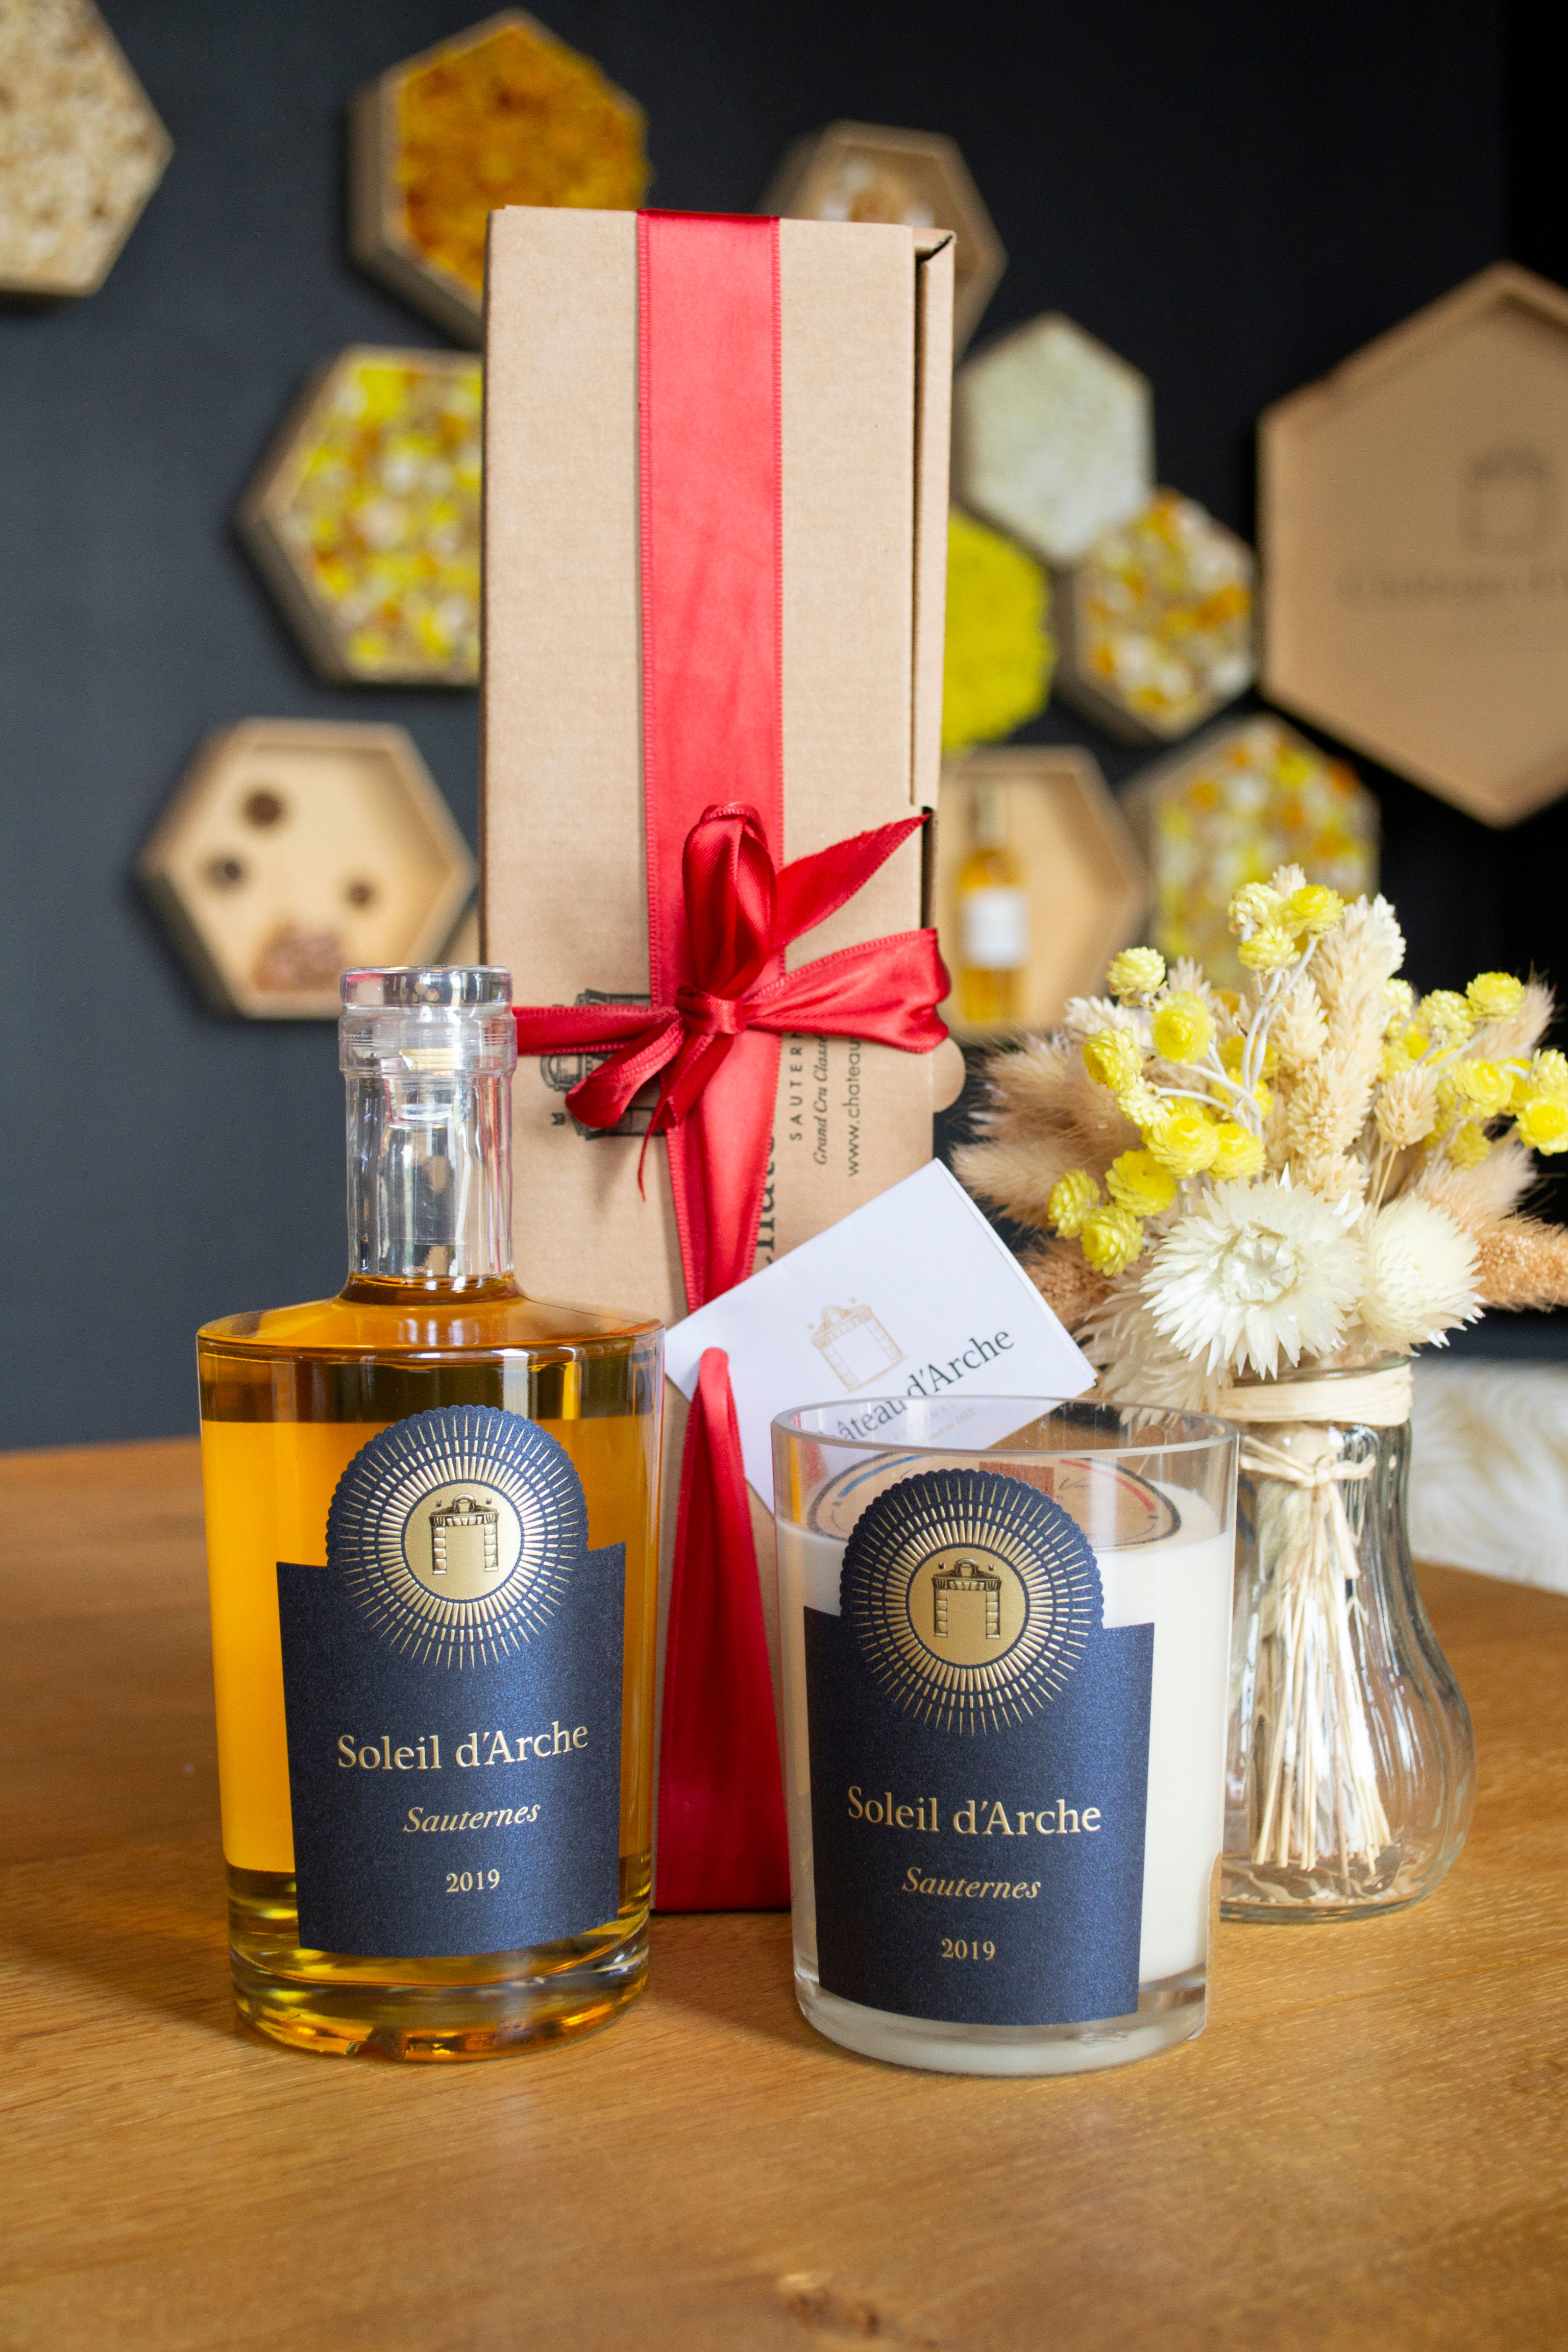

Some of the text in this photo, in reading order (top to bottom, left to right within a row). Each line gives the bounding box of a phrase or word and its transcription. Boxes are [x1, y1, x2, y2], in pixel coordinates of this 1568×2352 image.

[814, 1086, 827, 1113] Cru
[813, 1115, 827, 1165] Grand
[836, 1400, 908, 1440] âteau
[906, 1331, 1014, 1397] d'Arche
[337, 1721, 589, 1770] Soleil d'Arche
[403, 1804, 541, 1833] Sauternes
[848, 1785, 1101, 1836] Soleil d'Arche
[446, 1868, 500, 1893] 2019
[901, 1867, 1041, 1899] Sauternes
[941, 1938, 996, 1961] 2019
